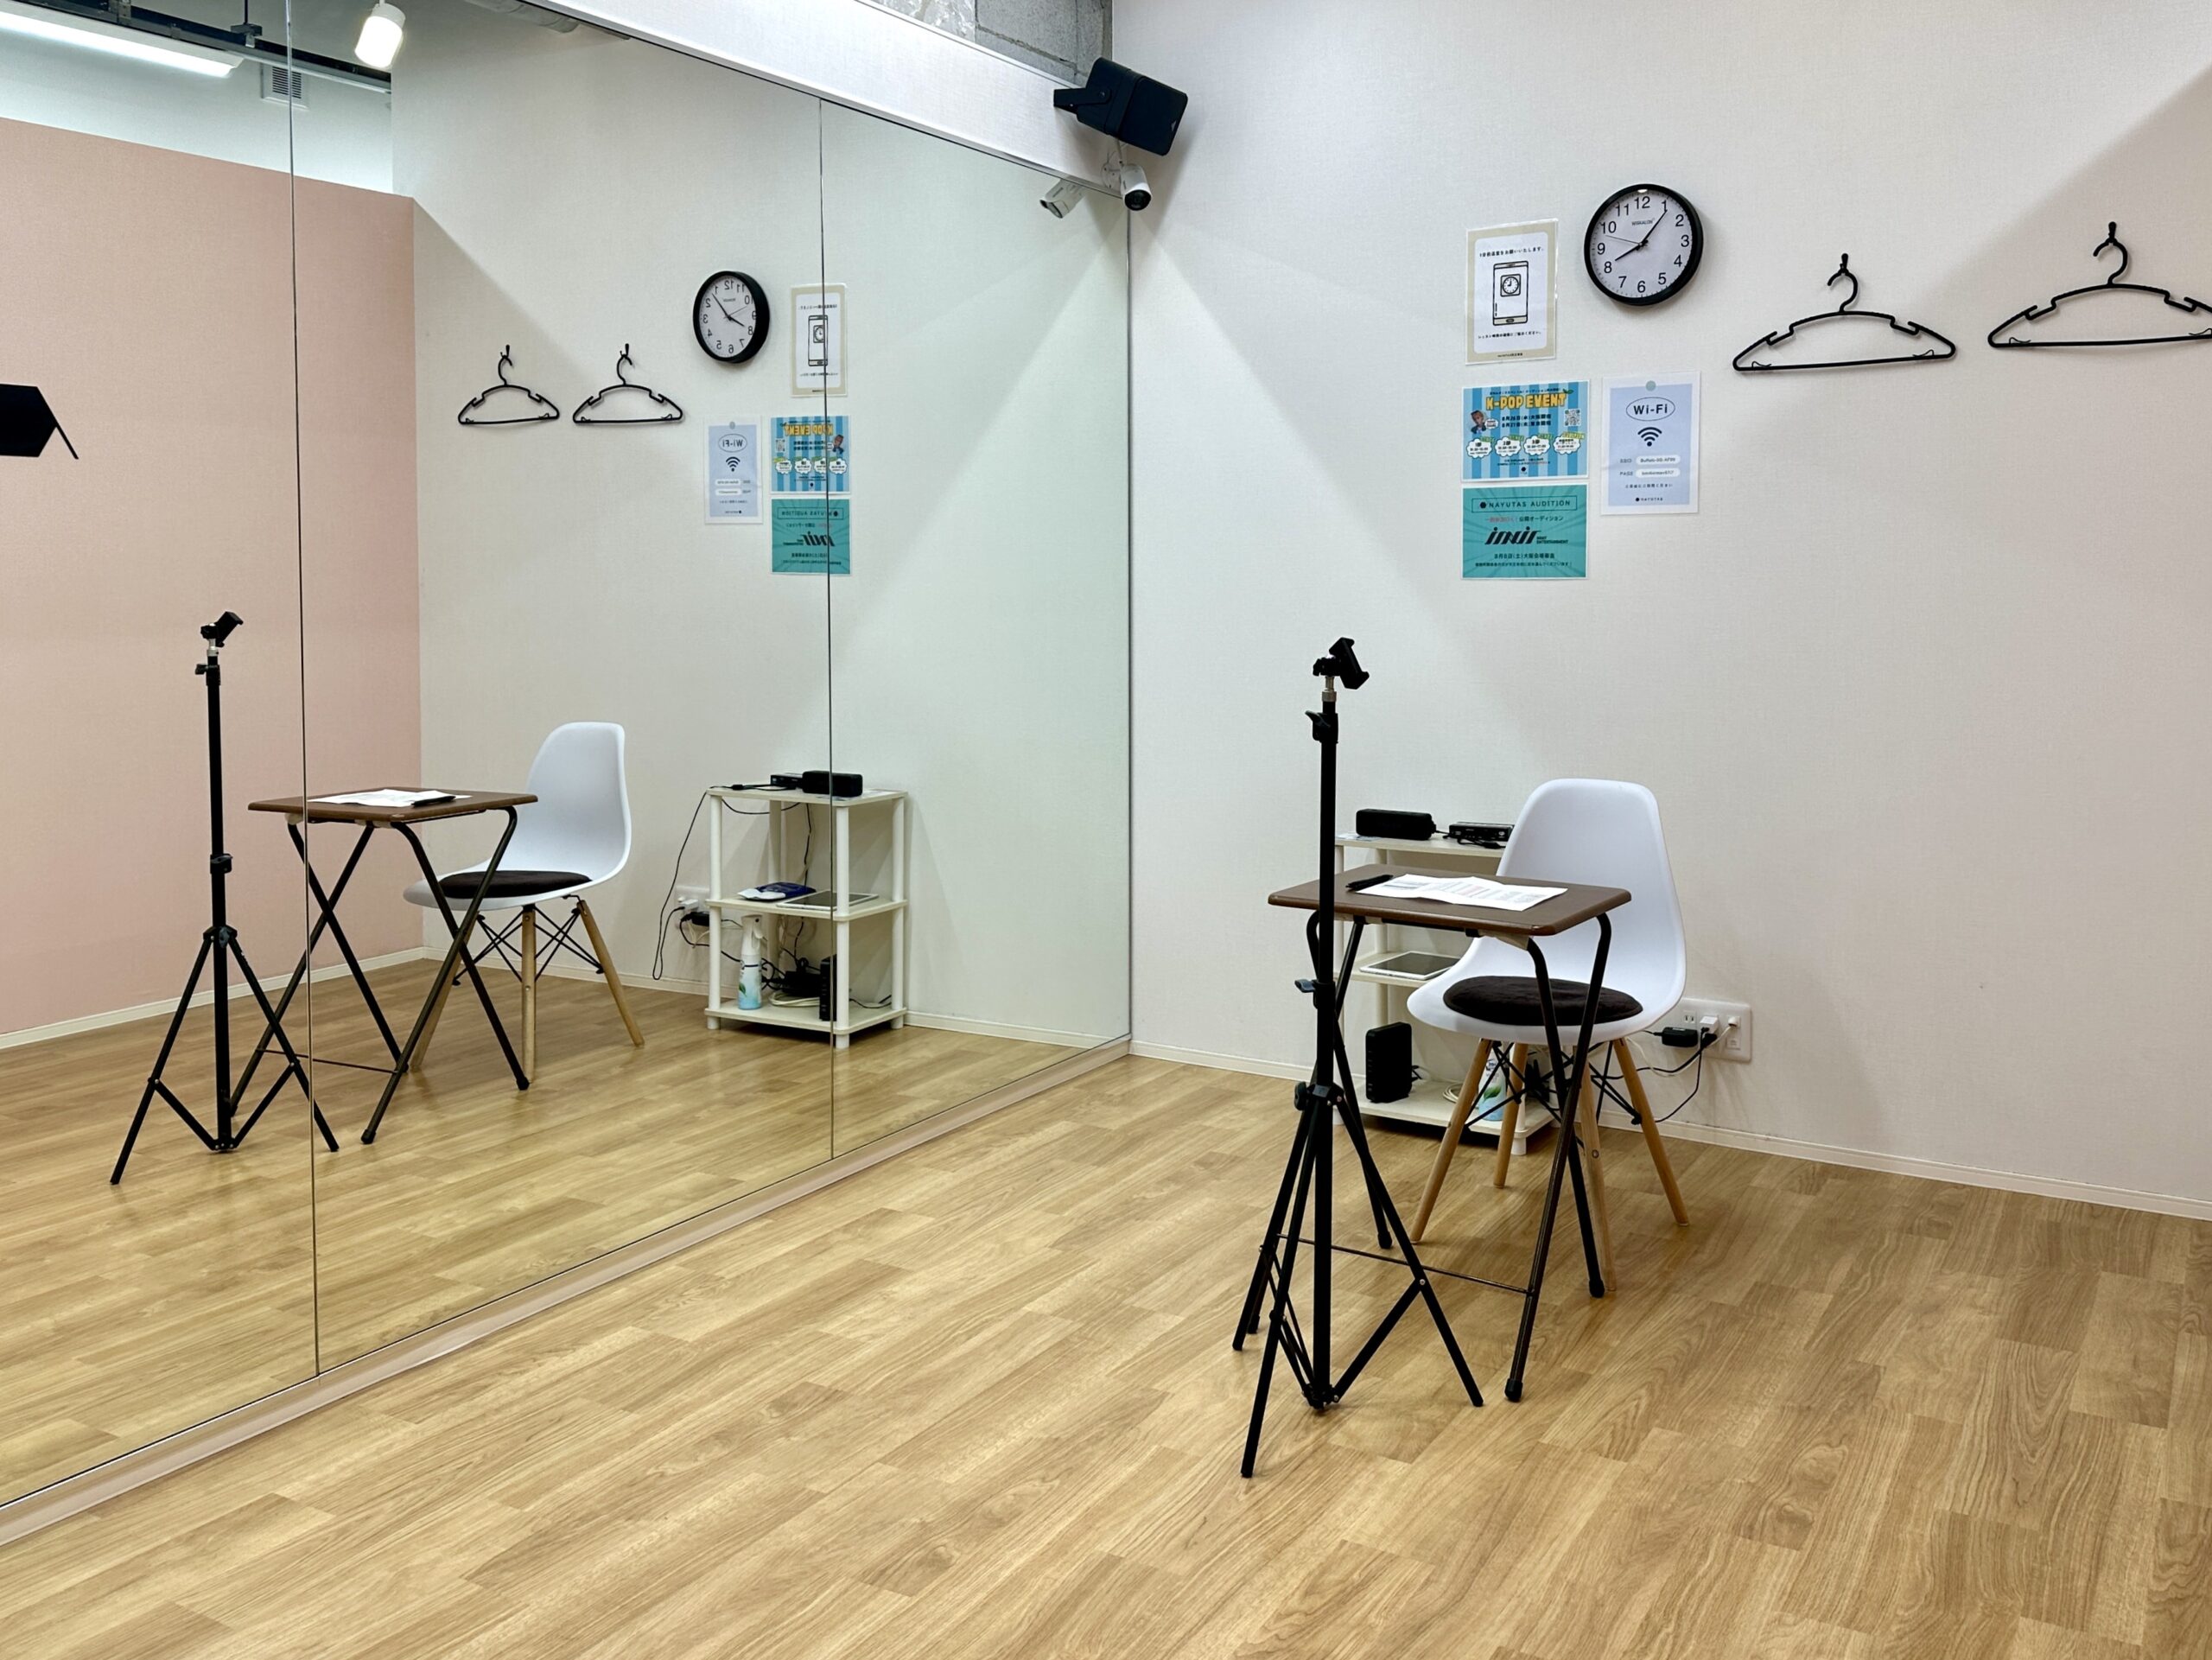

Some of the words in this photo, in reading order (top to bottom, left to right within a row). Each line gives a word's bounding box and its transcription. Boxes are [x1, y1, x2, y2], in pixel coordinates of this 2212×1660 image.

[1634, 196, 1650, 209] 12
[1662, 200, 1668, 212] 1
[1616, 204, 1630, 217] 11
[1675, 214, 1684, 227] 2
[1600, 221, 1617, 234] 10
[1681, 234, 1690, 247] 3
[1597, 243, 1605, 255] 9
[1604, 261, 1612, 273] 8
[1674, 254, 1682, 267] 4
[1618, 276, 1627, 288] 7
[1658, 272, 1667, 285] 5
[1637, 281, 1646, 293] 6
[1486, 395, 1524, 410] K-POP
[1525, 392, 1567, 409] EVENT
[1633, 404, 1669, 415] Wi-Fi
